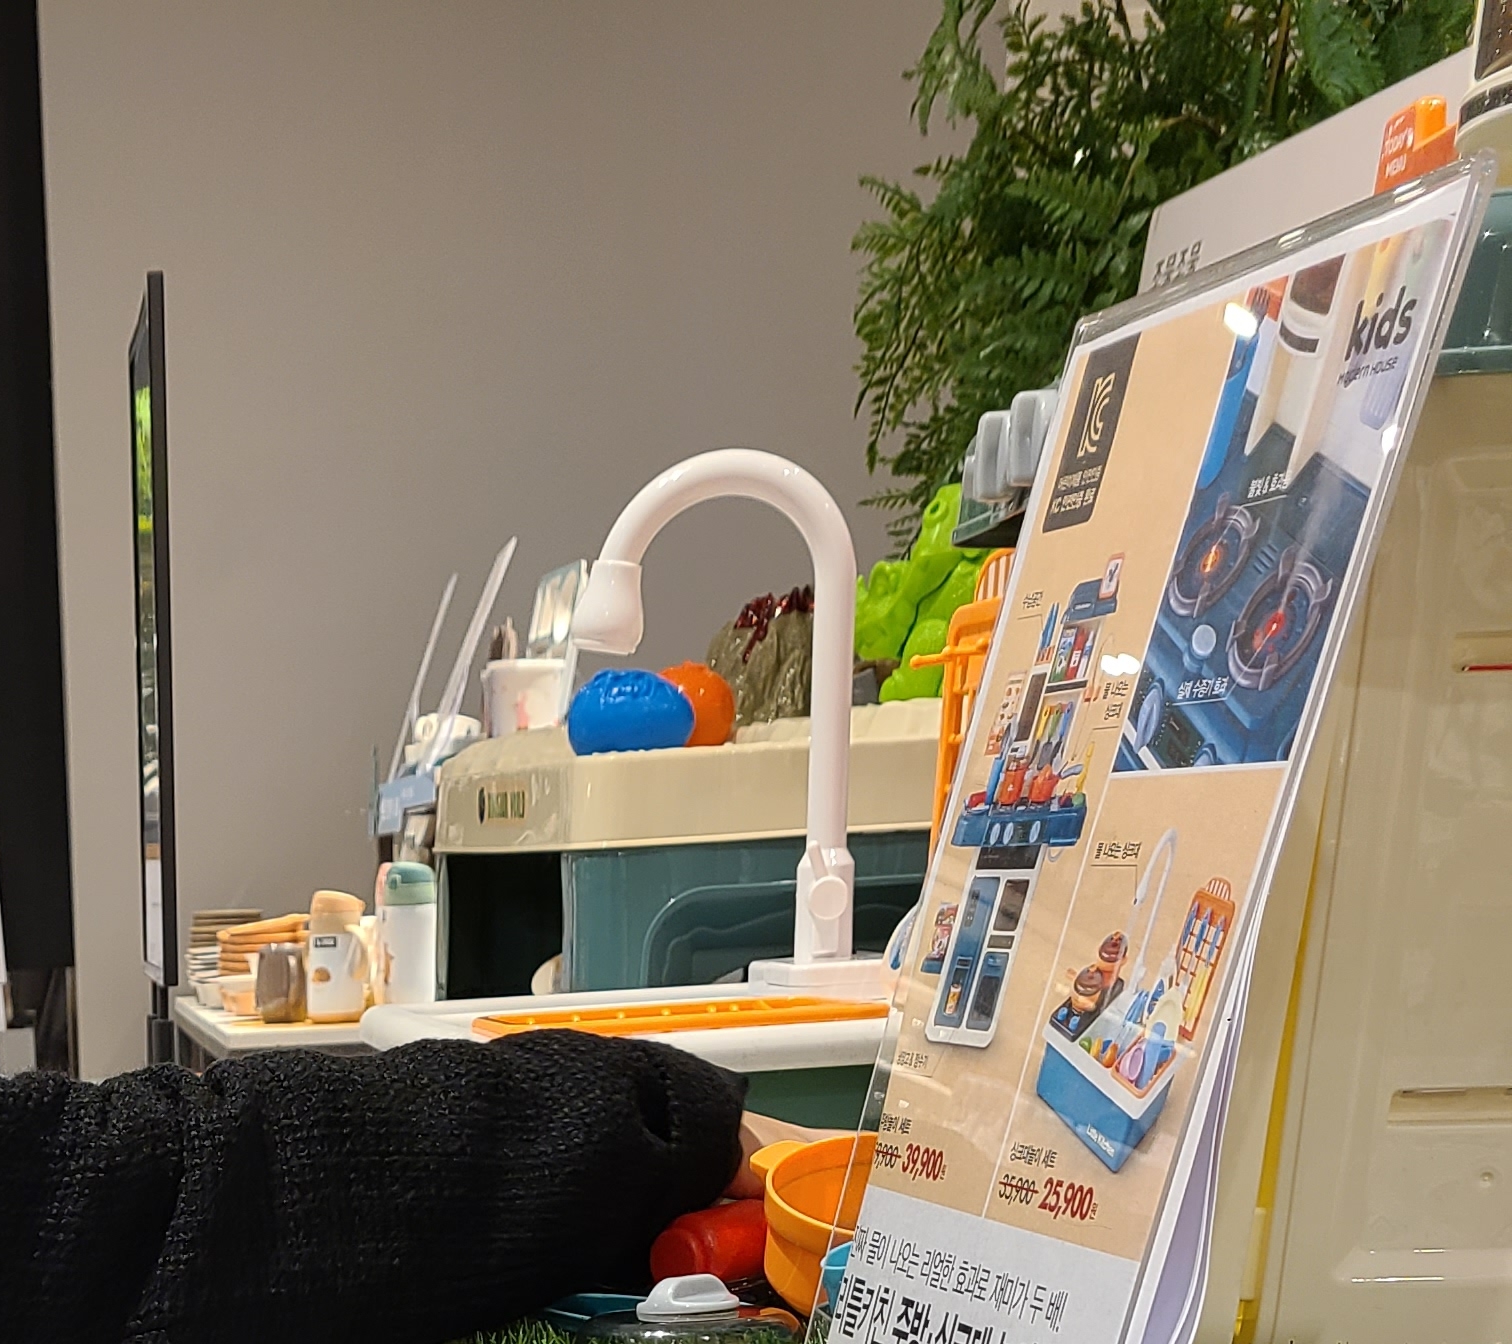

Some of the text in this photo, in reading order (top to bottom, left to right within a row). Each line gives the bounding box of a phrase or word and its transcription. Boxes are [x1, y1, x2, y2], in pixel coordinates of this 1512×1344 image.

[1344, 286, 1417, 361] kids
[1094, 842, 1104, 860] 물
[873, 1141, 900, 1170] 9,900
[901, 1143, 944, 1182] 39,900
[999, 1173, 1037, 1205] 35,900
[1038, 1176, 1094, 1221] 25,900
[866, 1230, 890, 1269] 물이
[890, 1236, 919, 1280] 나오는
[920, 1248, 956, 1292] 리얼한
[953, 1260, 990, 1302] 효과로
[990, 1272, 1030, 1319] 재미가
[1029, 1285, 1047, 1324] 두
[1045, 1290, 1069, 1332] 배!
